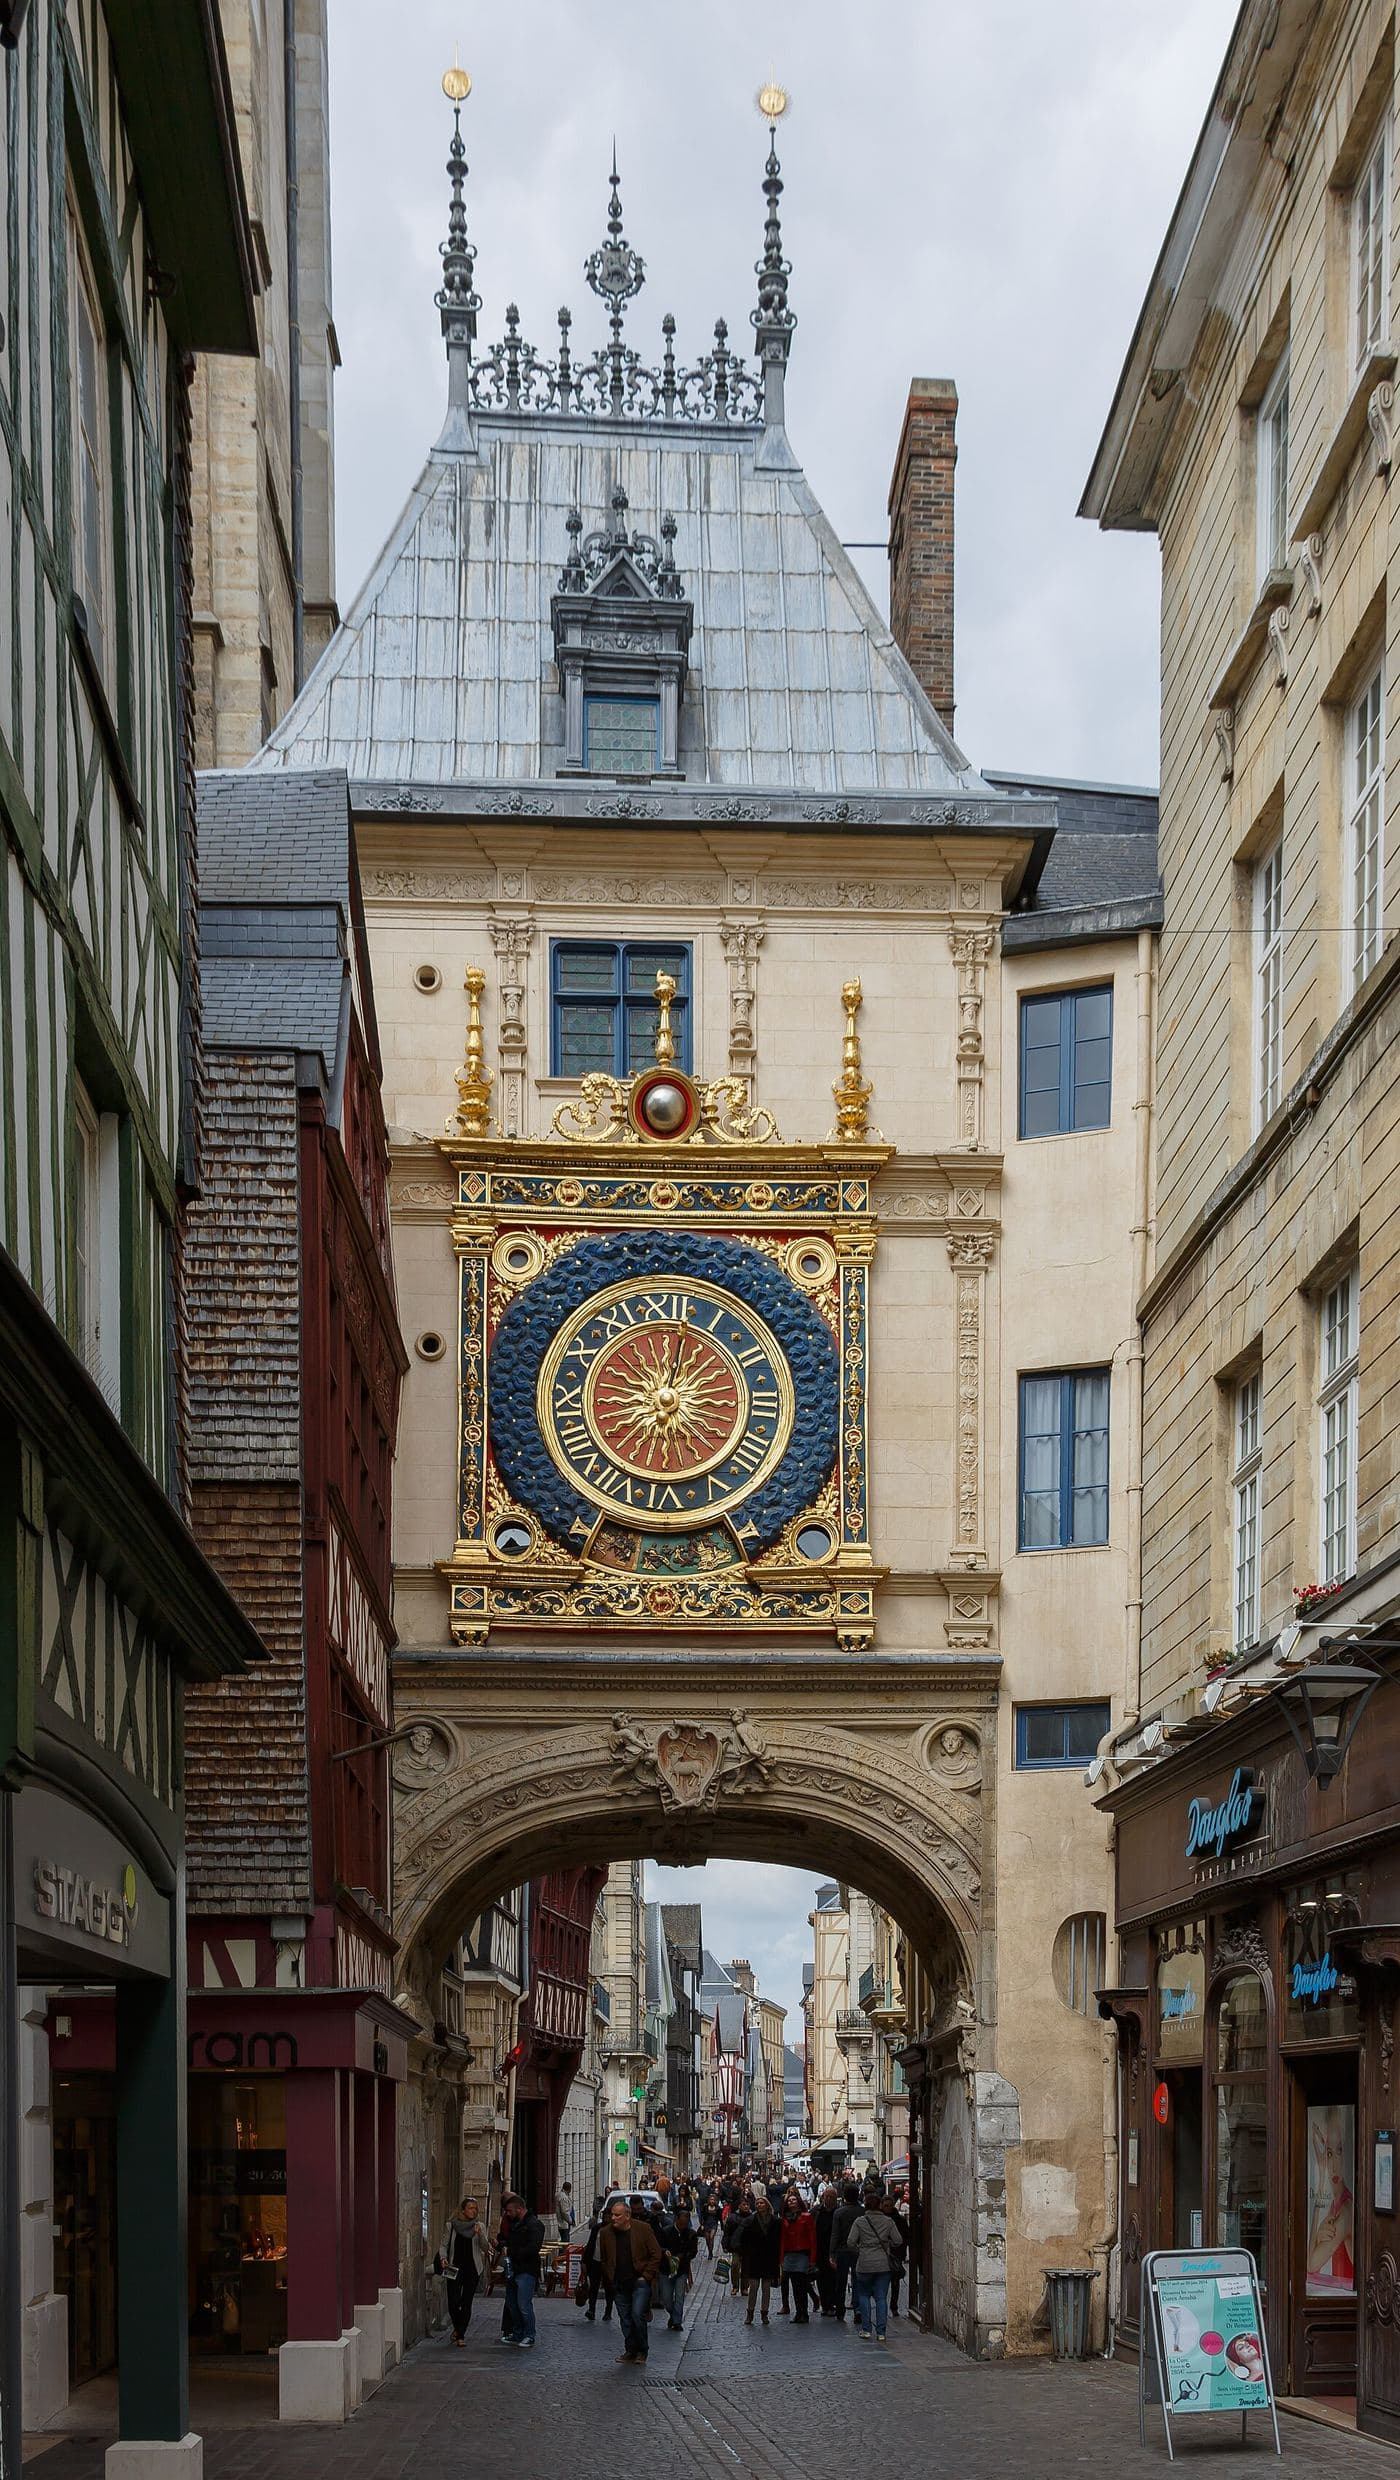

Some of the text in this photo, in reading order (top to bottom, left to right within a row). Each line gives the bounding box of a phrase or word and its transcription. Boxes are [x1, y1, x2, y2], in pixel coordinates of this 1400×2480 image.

[643, 1294, 689, 1321] XII
[1185, 1766, 1253, 1858] Douglas
[1291, 1952, 1338, 2005] Douglas
